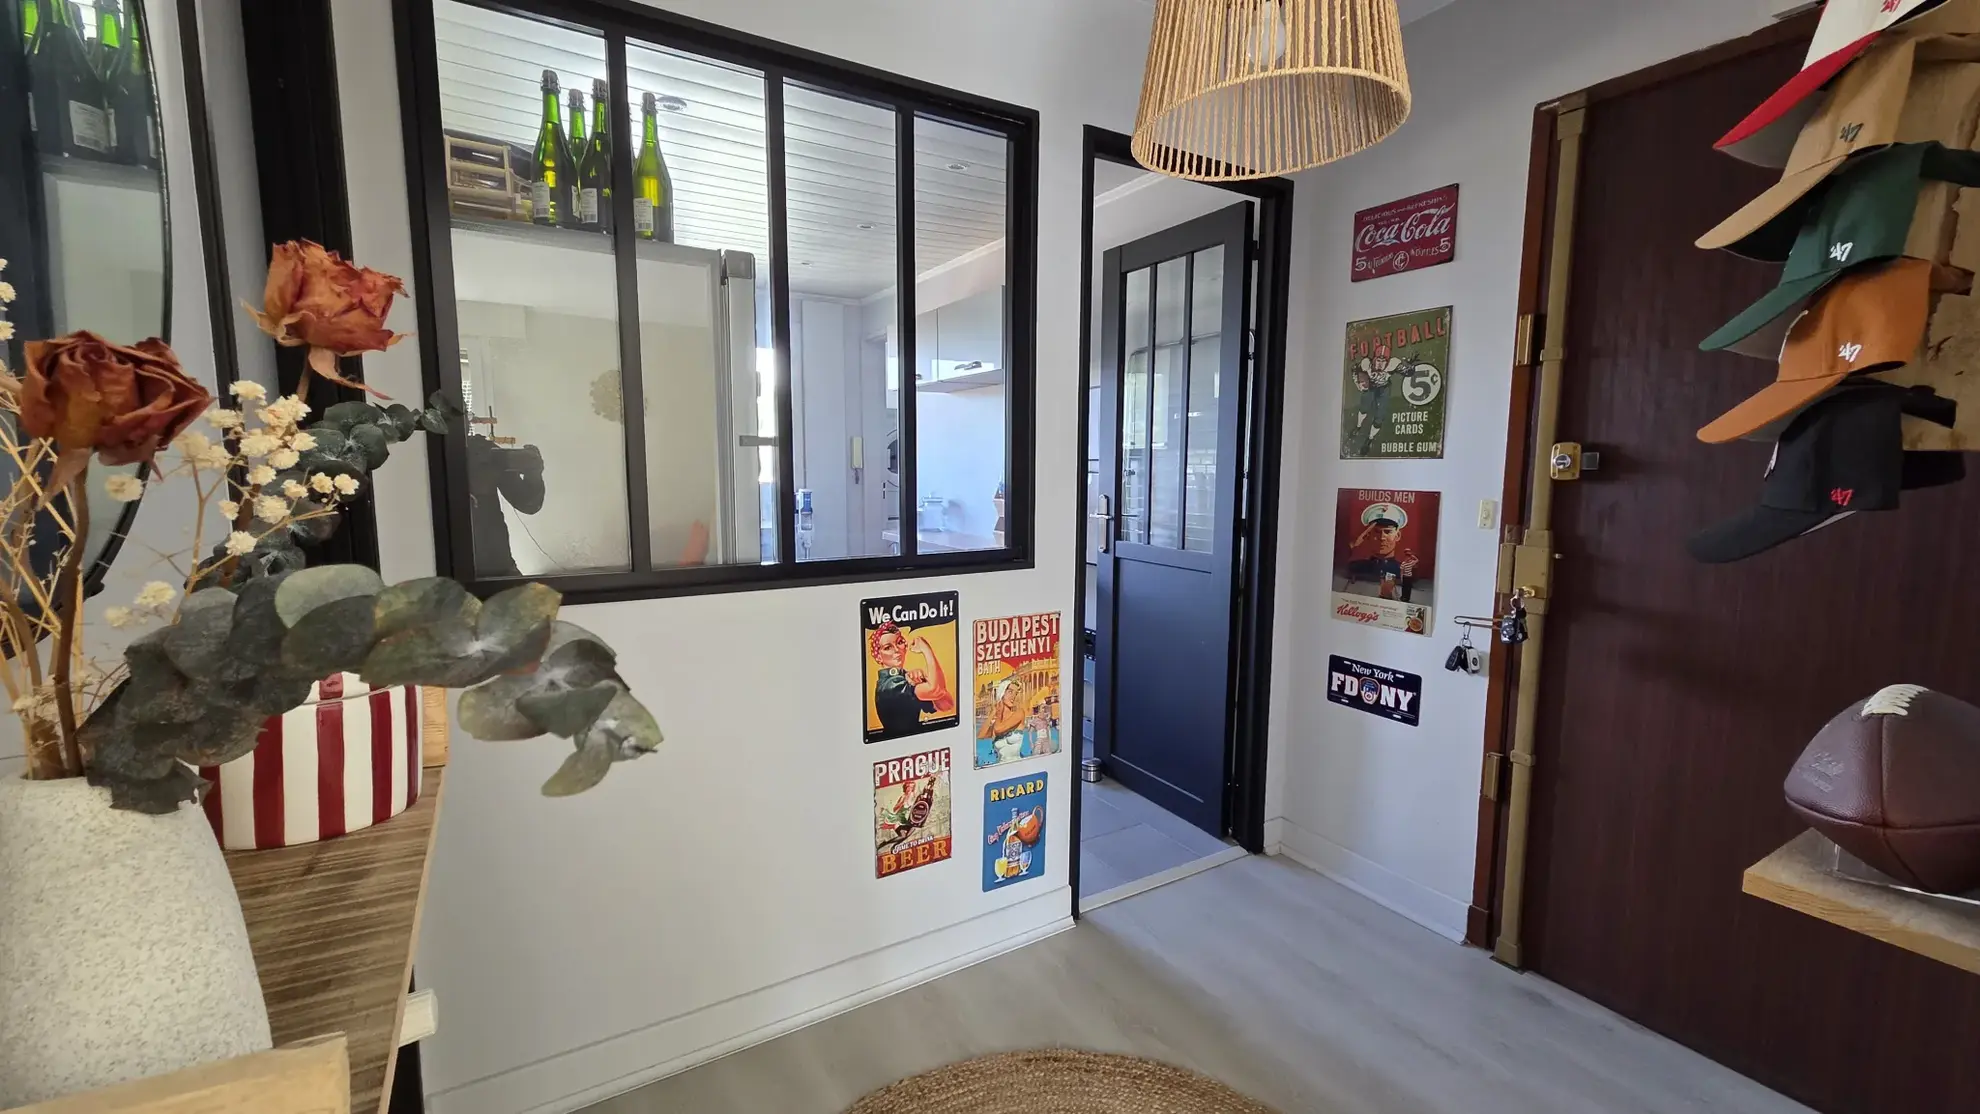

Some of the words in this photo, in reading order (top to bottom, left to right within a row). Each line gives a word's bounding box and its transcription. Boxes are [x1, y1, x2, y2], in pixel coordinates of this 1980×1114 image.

[1440, 237, 1451, 252] 5
[1355, 256, 1367, 271] 5
[1391, 411, 1429, 423] PICTURE
[1395, 424, 1424, 435] CARDS
[1381, 442, 1414, 453] BUBBLE
[1416, 441, 1437, 452] GUM
[1358, 489, 1392, 502] BUILDS
[1393, 491, 1416, 504] MEN
[868, 606, 891, 625] We
[892, 604, 918, 622] Can
[919, 602, 938, 620] Do
[939, 599, 954, 618] It!
[976, 613, 1060, 645] BUDAPEST
[976, 636, 1051, 662] SZECHENYI
[977, 660, 1001, 676] BATH
[1351, 663, 1373, 676] New
[1373, 668, 1394, 683] York
[875, 749, 950, 788] PRAGUE
[990, 779, 1044, 803] RICARD
[881, 839, 949, 875] BEER
